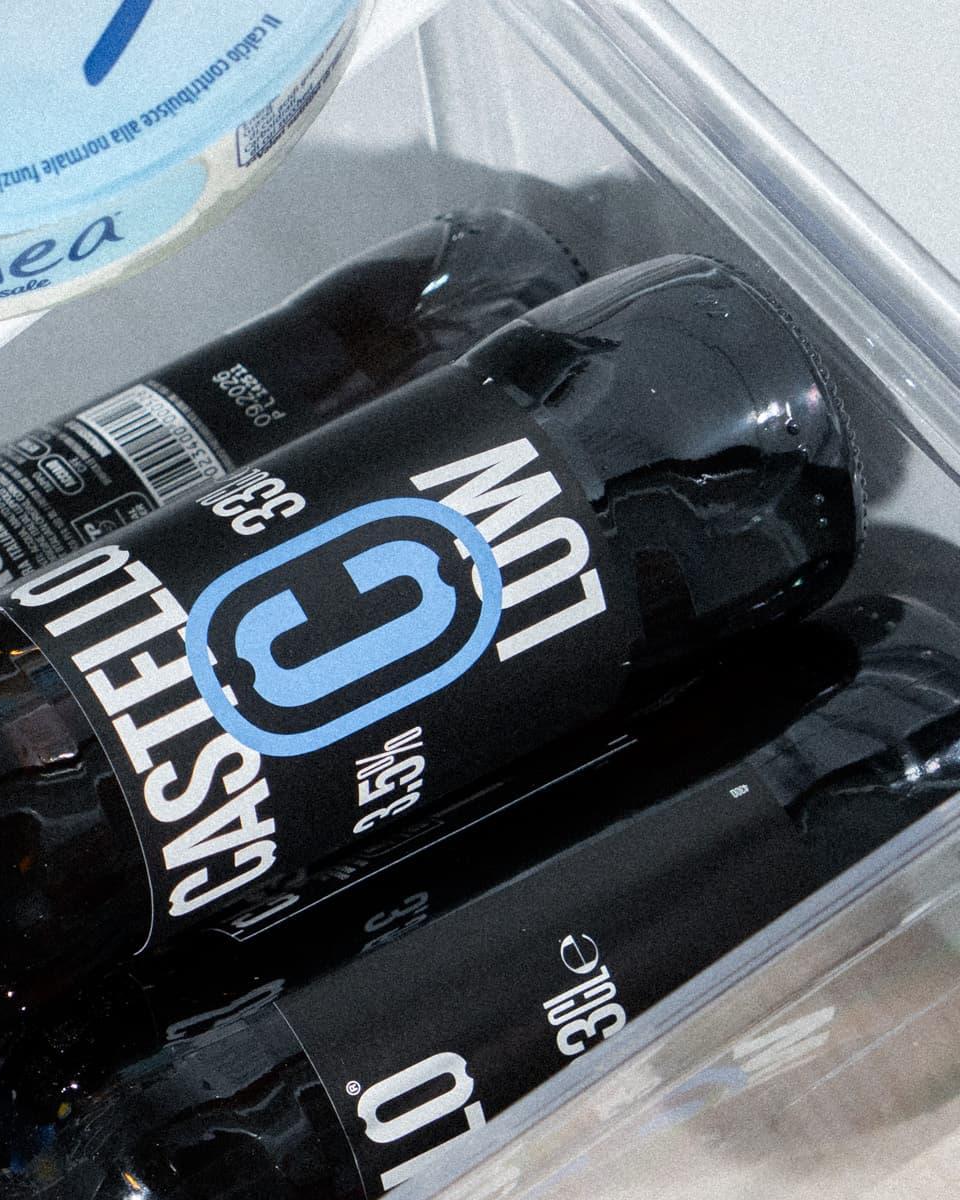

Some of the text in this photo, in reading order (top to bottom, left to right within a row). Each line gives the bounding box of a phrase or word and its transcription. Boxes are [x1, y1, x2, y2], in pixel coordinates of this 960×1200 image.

[227, 25, 270, 69] calcio
[140, 56, 233, 128] contribuisce
[41, 131, 111, 175] normale
[110, 116, 142, 147] alla
[10, 544, 277, 917] CASTELLO
